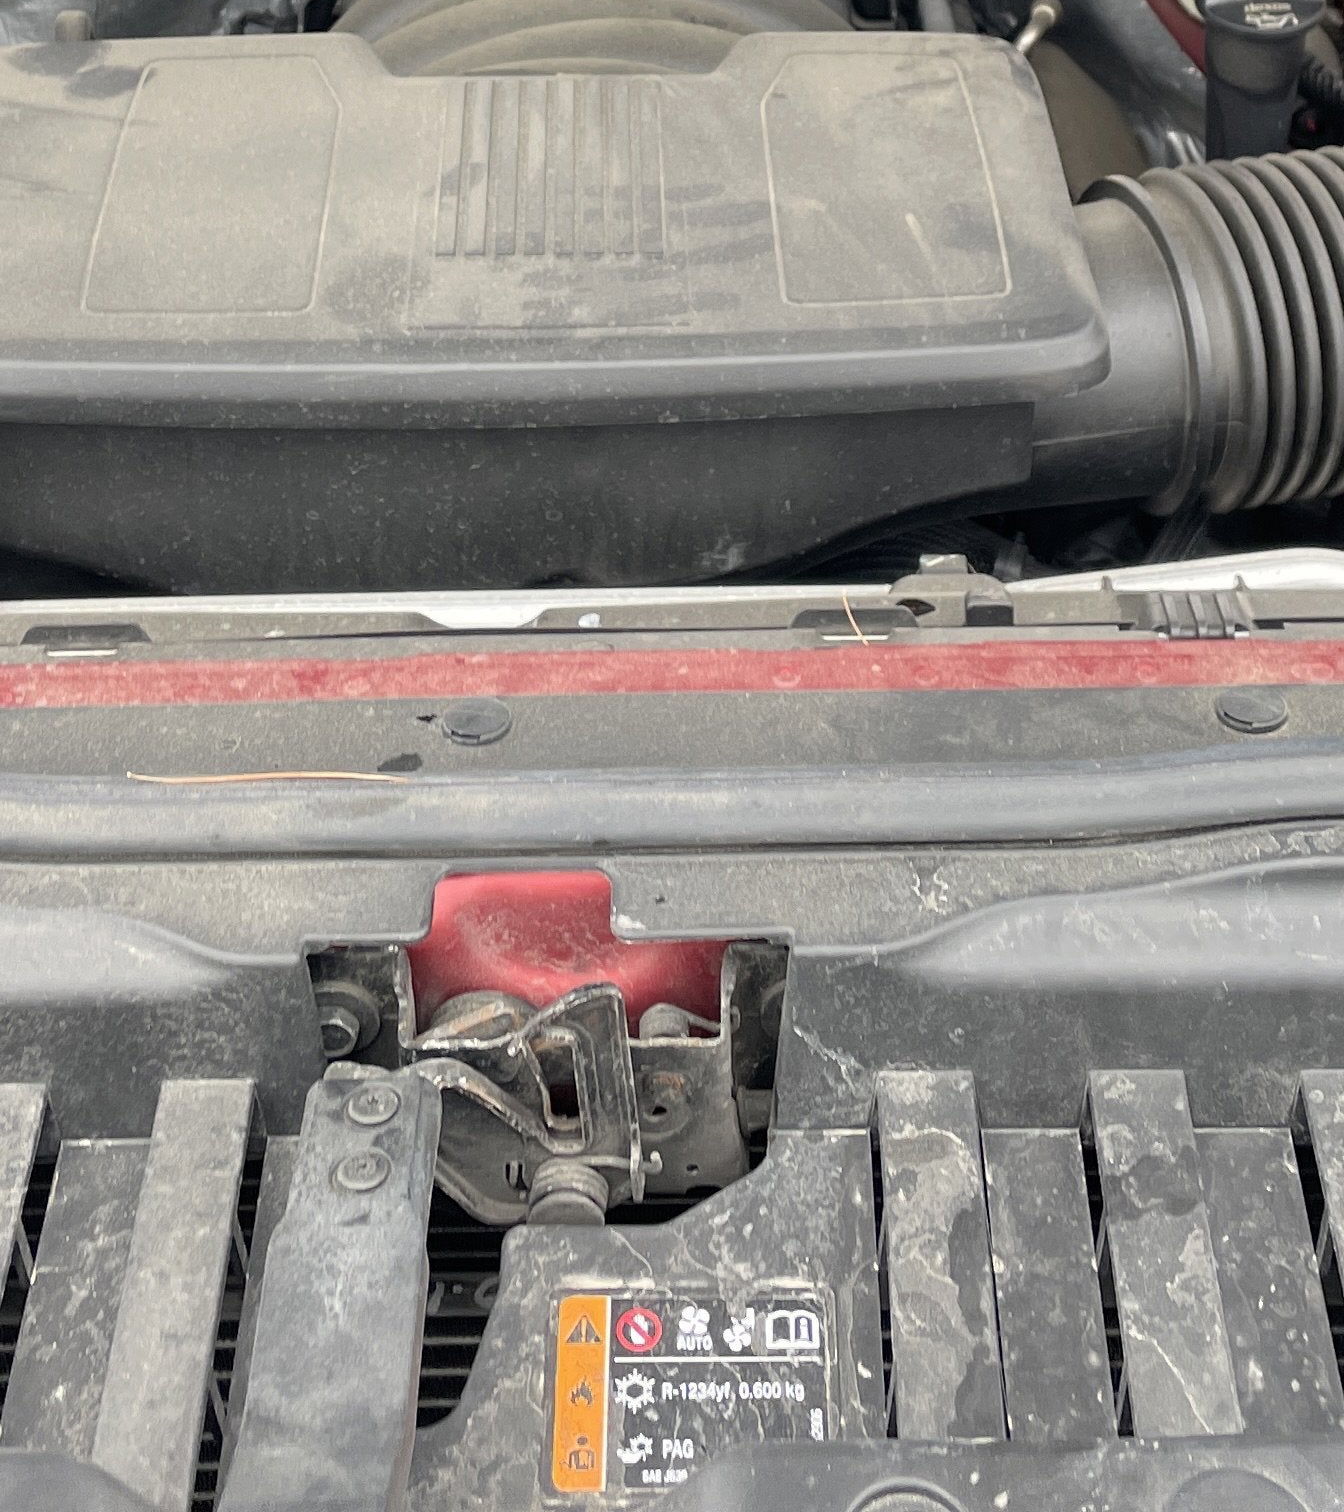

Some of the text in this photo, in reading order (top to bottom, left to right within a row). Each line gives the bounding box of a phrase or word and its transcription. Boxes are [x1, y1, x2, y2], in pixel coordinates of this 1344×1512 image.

[676, 1334, 712, 1351] AUTO
[661, 1381, 730, 1402] R-1234yf
[785, 1380, 805, 1402] kg
[662, 1438, 694, 1459] PAG
